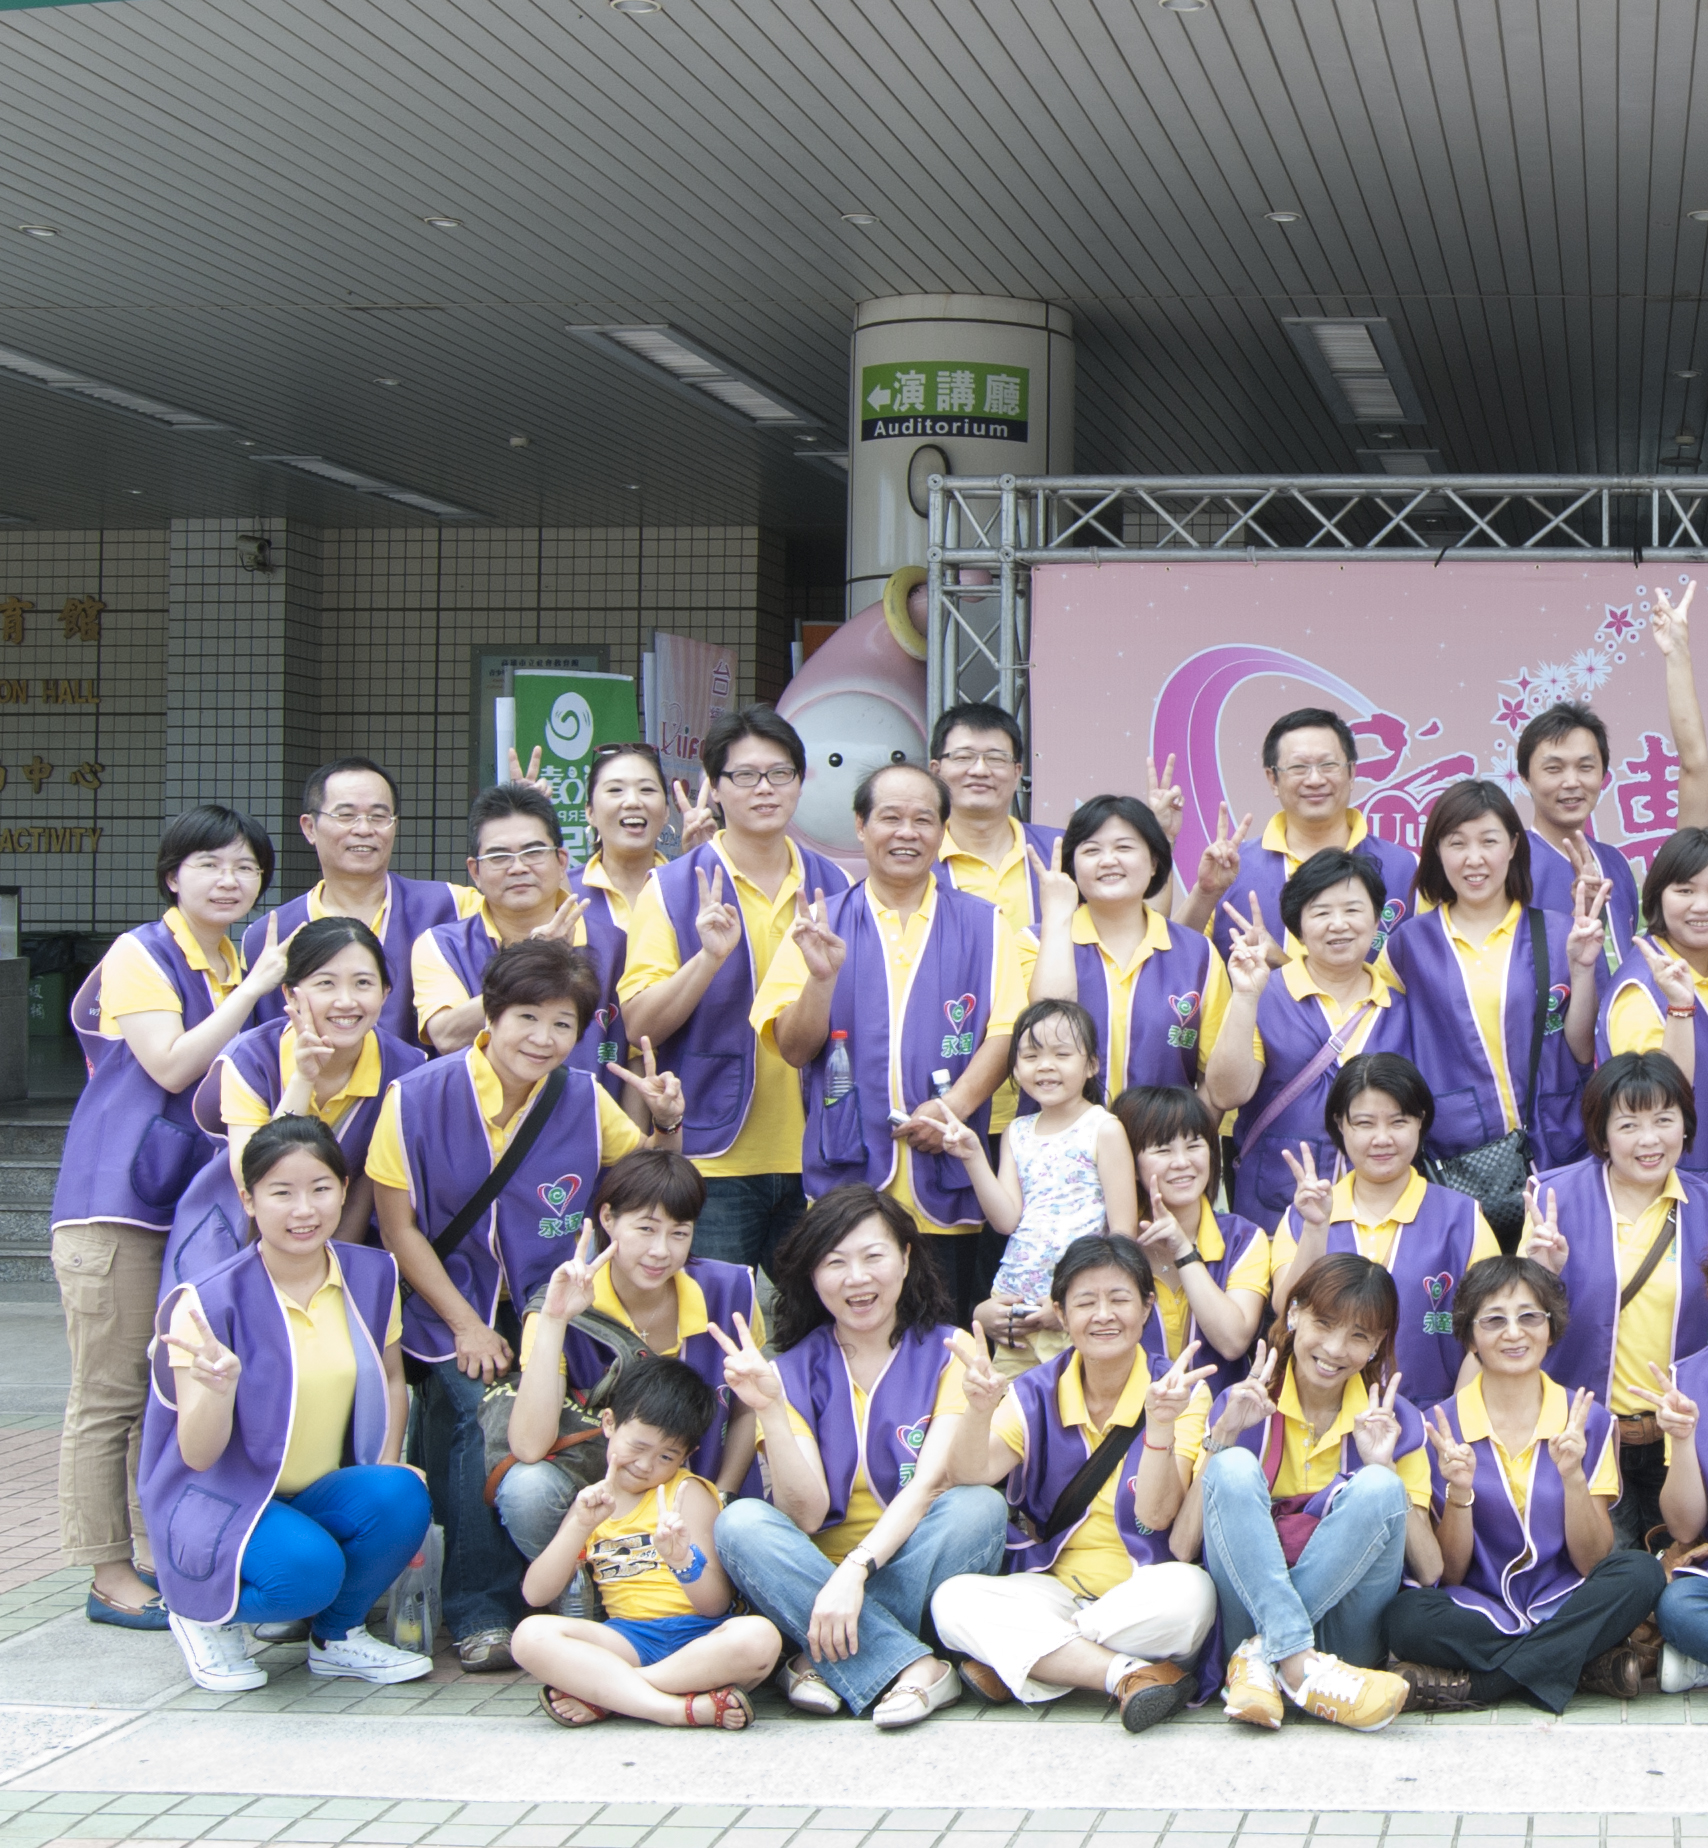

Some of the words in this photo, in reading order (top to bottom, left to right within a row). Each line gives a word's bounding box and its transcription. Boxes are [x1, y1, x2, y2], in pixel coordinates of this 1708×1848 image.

[893, 370, 1020, 415] 演講廳
[874, 418, 1008, 437] Auditorium
[42, 680, 100, 704] HALL
[0, 755, 104, 794] 中心
[0, 827, 102, 853] ACTIVITY
[941, 1031, 974, 1058] 永達
[537, 1211, 585, 1239] 永達
